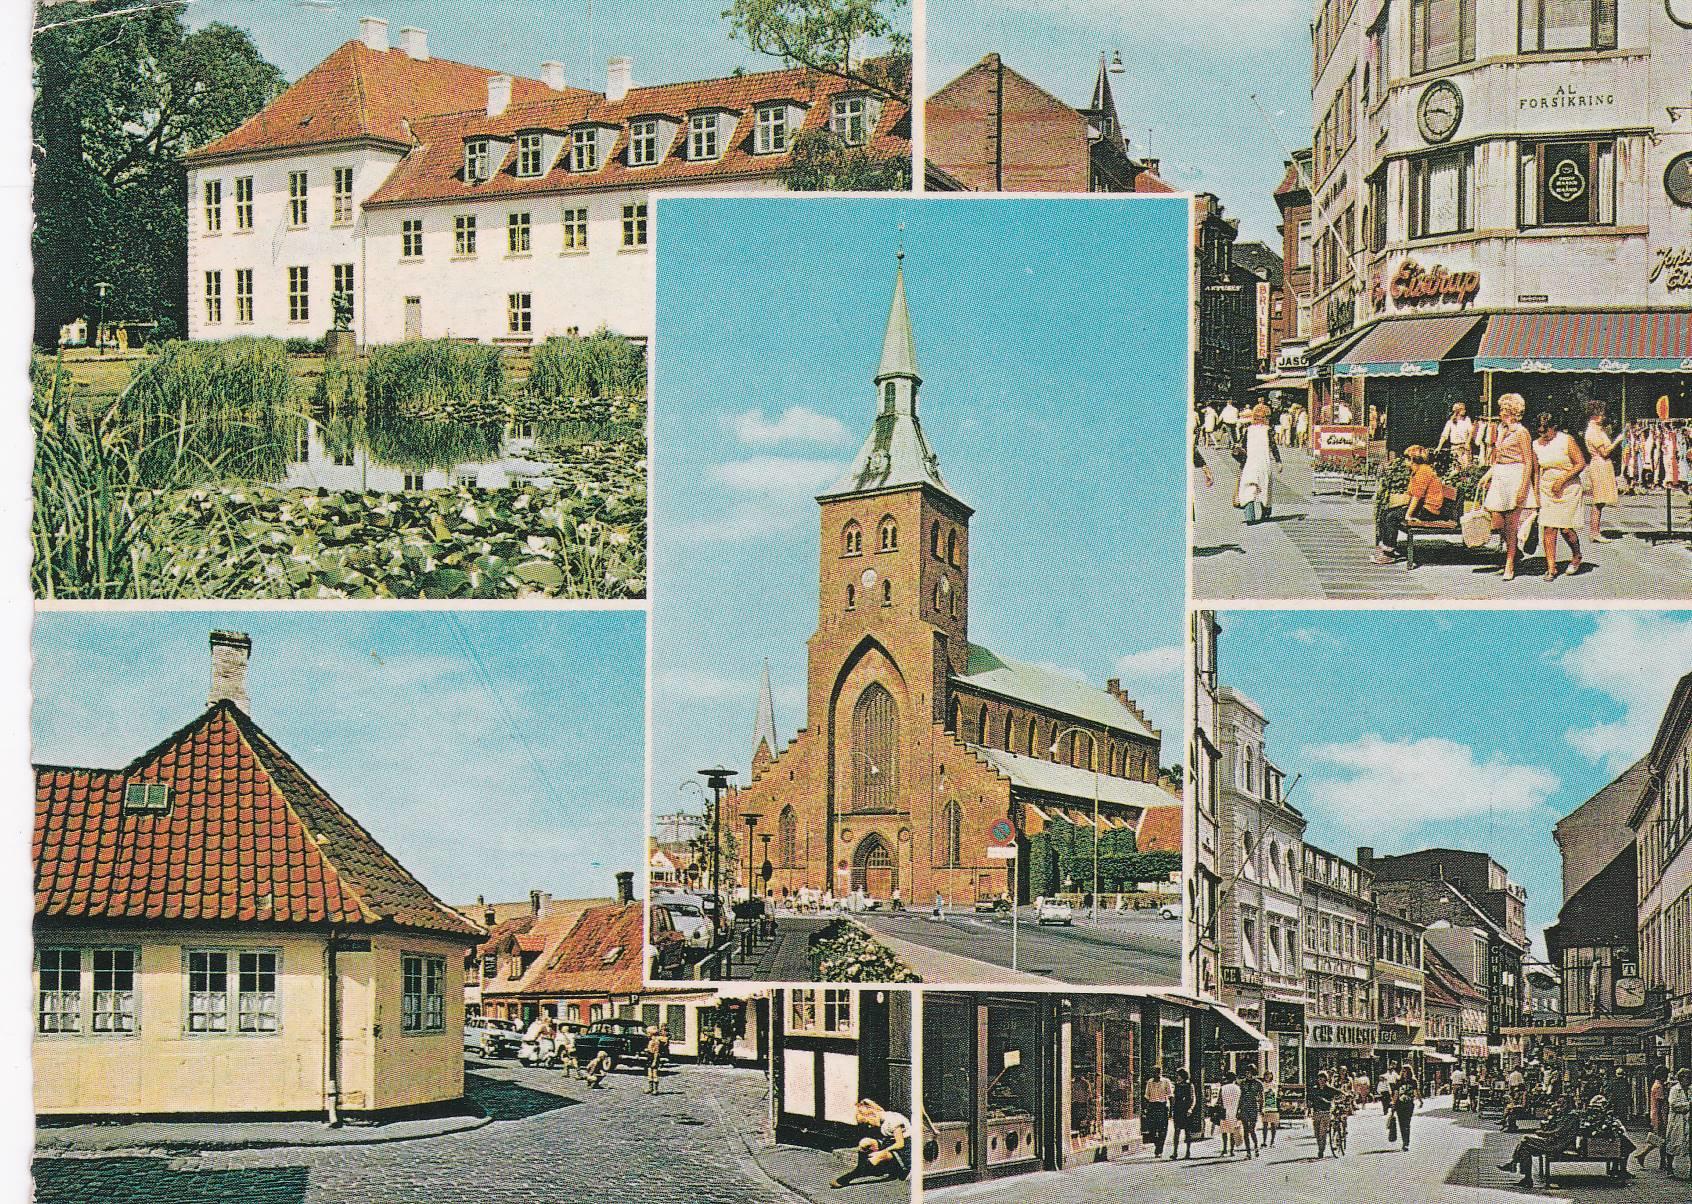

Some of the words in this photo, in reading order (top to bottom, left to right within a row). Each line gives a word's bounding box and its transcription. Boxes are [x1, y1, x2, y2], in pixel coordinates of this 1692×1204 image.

[1520, 95, 1615, 109] FORSIKRING
[1556, 84, 1577, 95] AL
[1259, 284, 1267, 357] BRILLER
[1491, 945, 1500, 1034] CHRISTRUP
